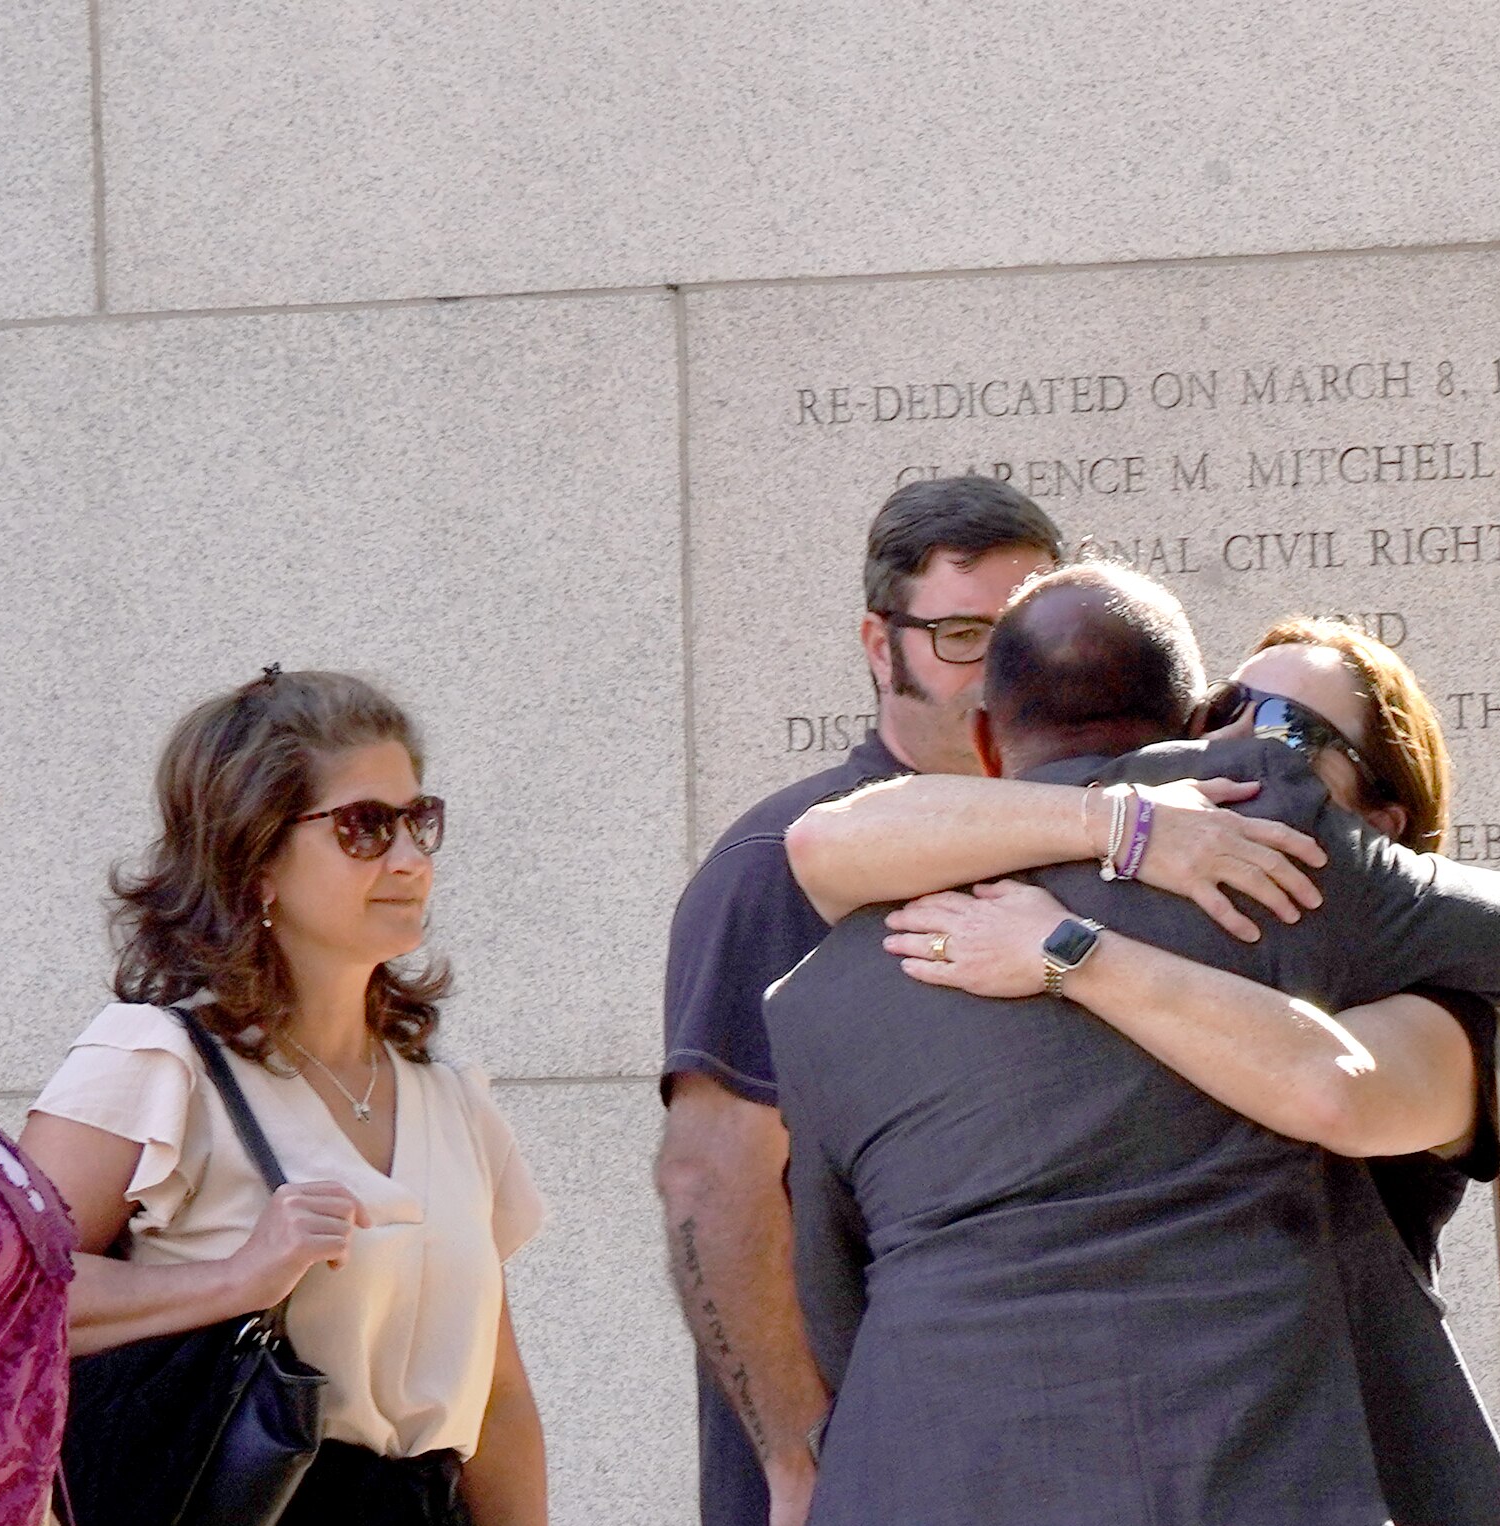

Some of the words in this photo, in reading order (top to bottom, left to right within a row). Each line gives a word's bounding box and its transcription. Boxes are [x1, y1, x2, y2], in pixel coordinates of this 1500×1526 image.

[796, 374, 1128, 426] RE-DEDICATED
[1150, 370, 1219, 410] ON
[1240, 361, 1413, 406] MARCH
[1222, 532, 1344, 573] CIVIL
